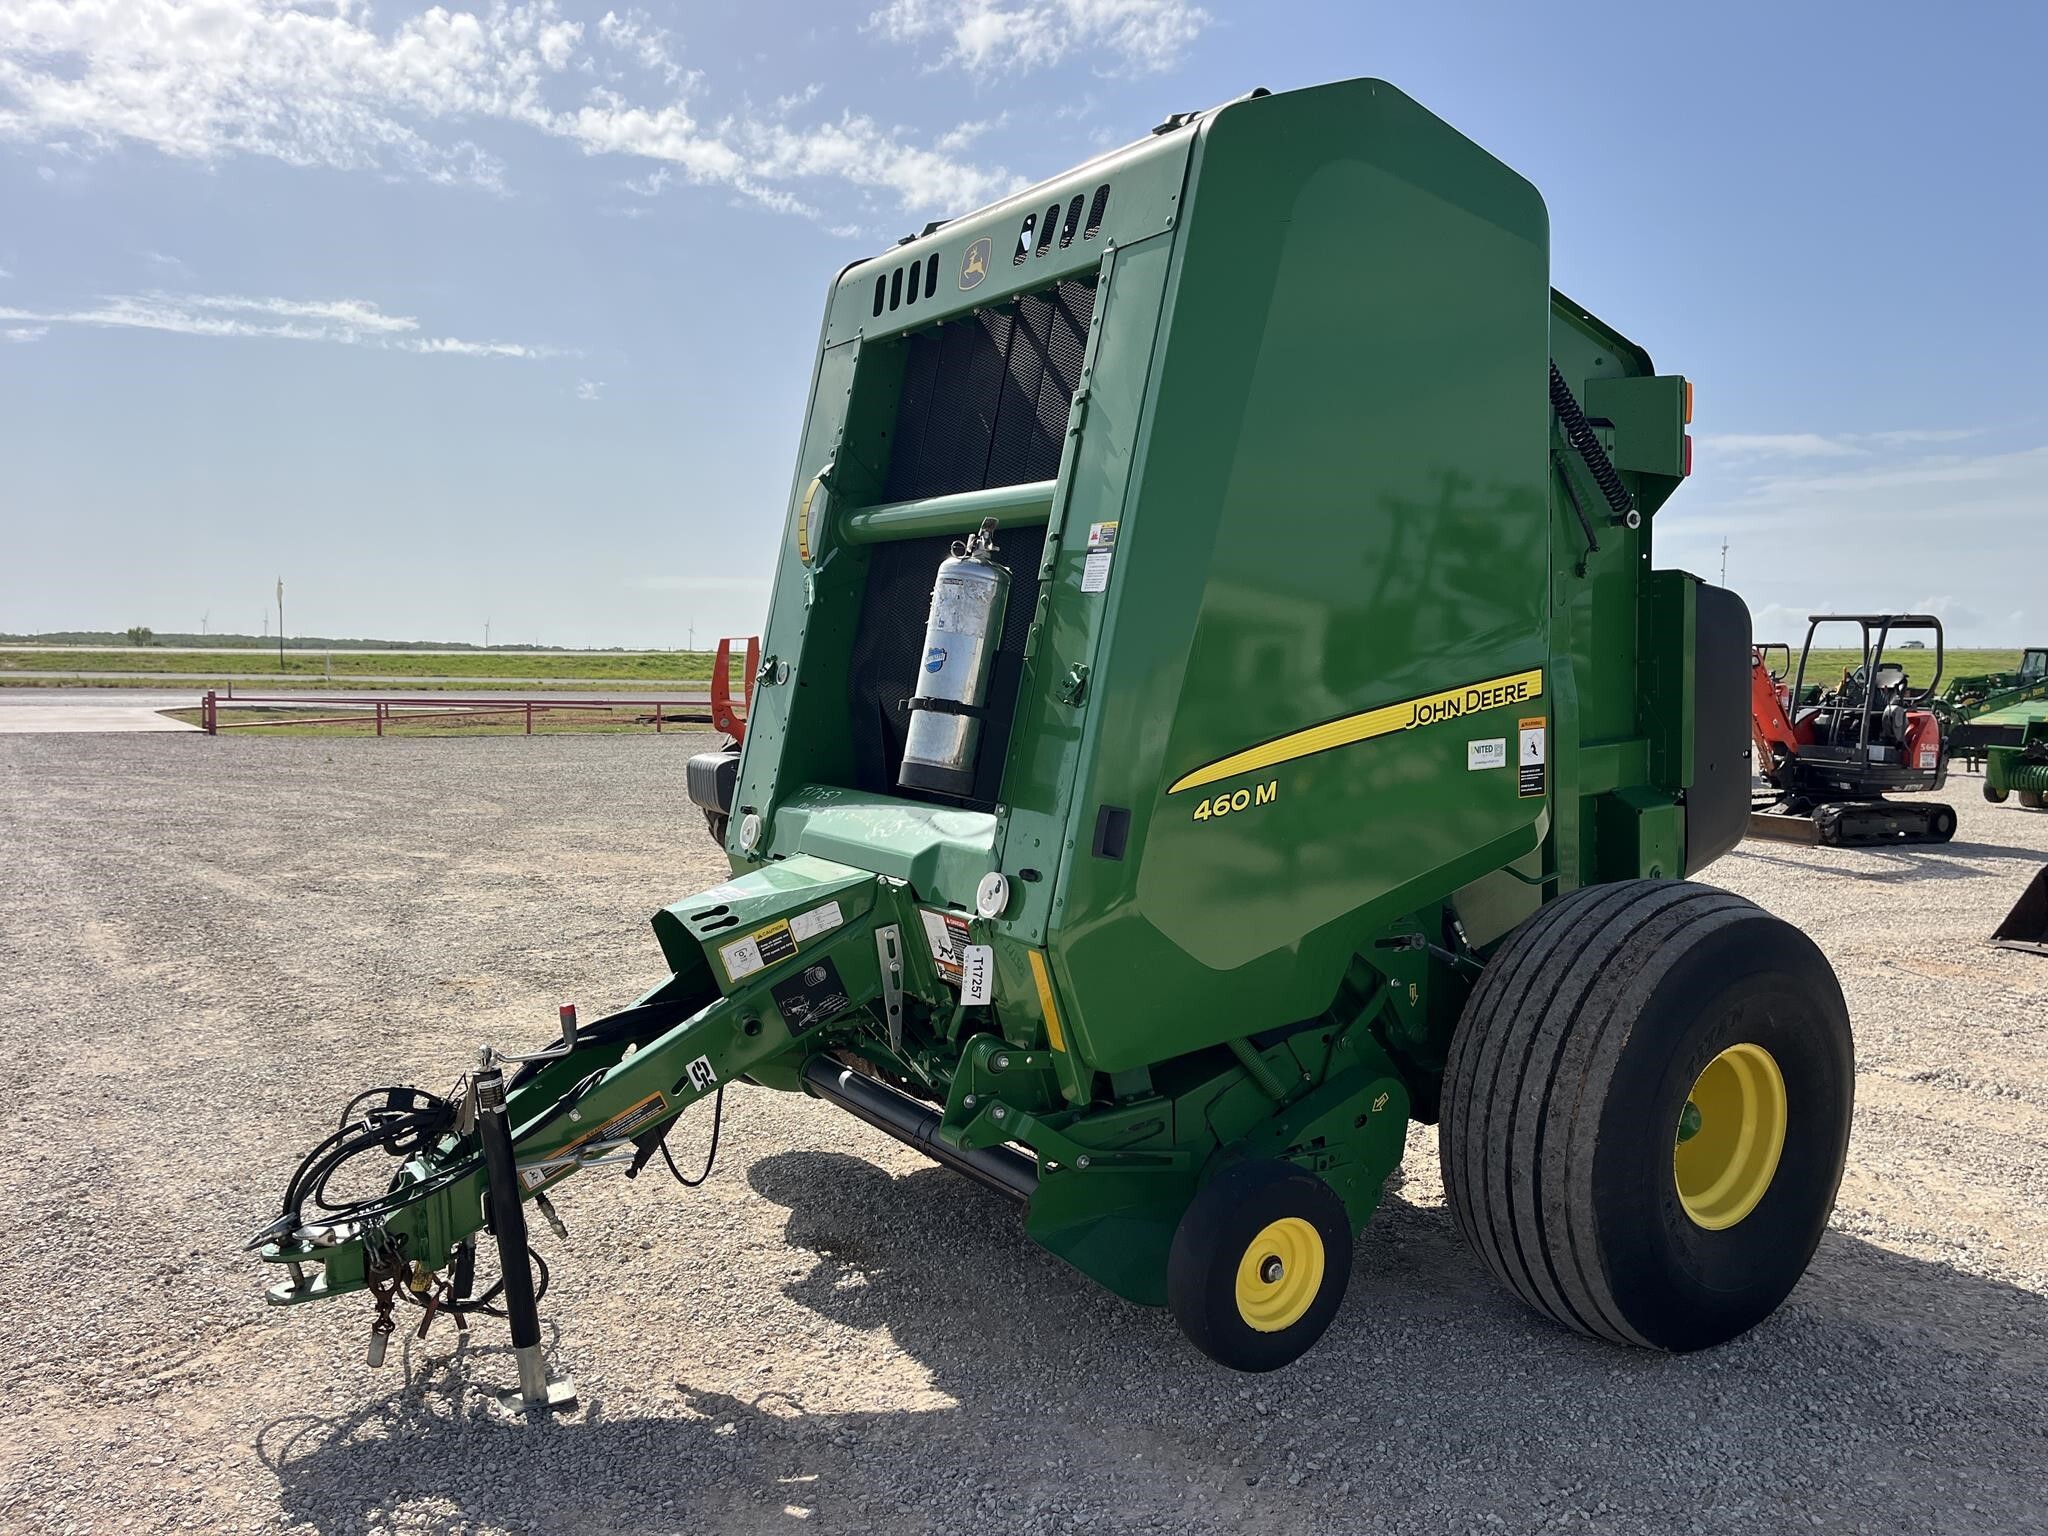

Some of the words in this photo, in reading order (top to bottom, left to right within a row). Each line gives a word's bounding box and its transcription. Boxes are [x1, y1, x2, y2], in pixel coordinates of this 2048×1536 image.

[1407, 698, 1460, 727] JOHN
[1466, 682, 1528, 708] DEERE
[1192, 788, 1251, 822] 460
[1255, 779, 1278, 806] M
[763, 924, 783, 936] CAUTION
[972, 956, 983, 999] T17257
